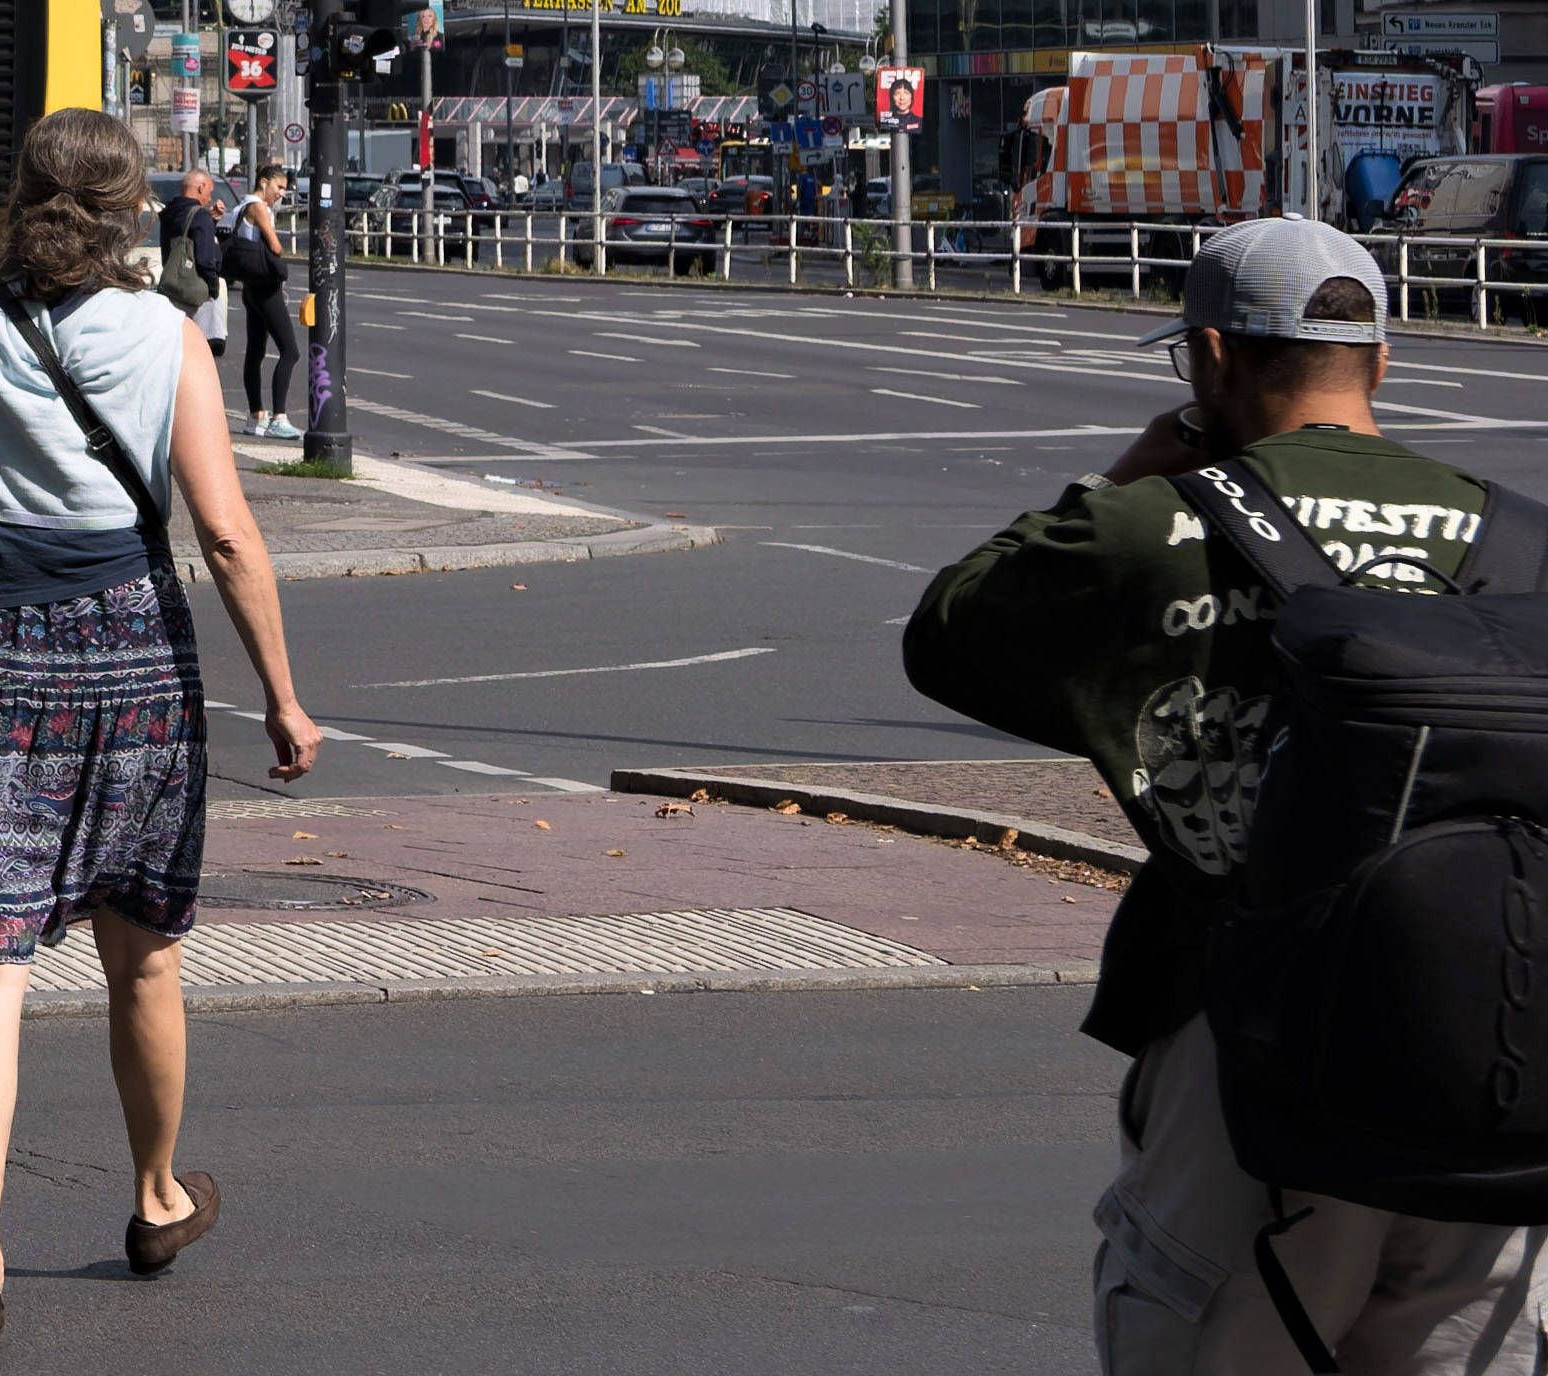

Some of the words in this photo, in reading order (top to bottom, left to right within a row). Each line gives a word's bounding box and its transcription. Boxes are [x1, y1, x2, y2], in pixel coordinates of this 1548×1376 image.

[241, 60, 263, 77] 36
[800, 86, 812, 95] 30
[1295, 105, 1306, 121] A
[1334, 104, 1435, 124] VORNE
